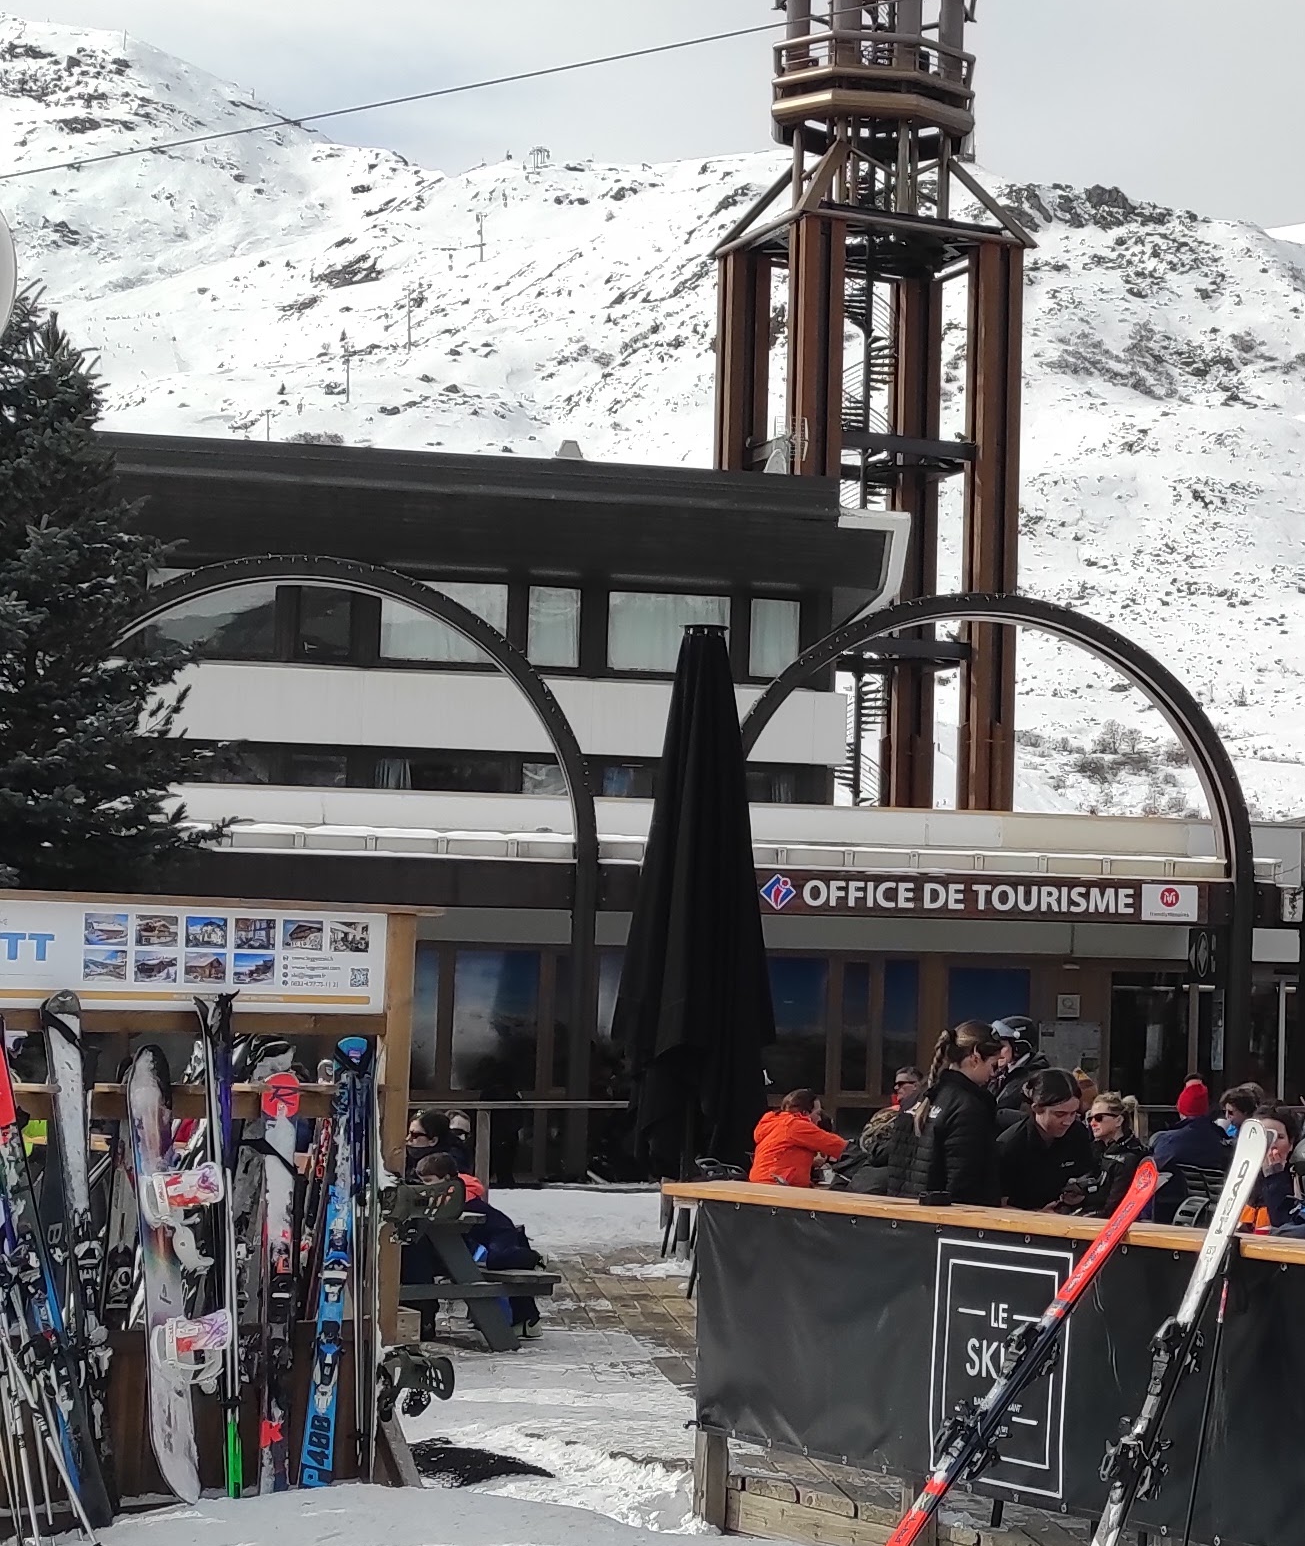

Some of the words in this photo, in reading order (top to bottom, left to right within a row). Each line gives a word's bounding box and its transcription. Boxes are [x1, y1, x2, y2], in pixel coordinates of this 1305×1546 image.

[802, 879, 915, 910] OFFICE
[923, 882, 965, 911] DE
[972, 883, 1135, 914] TOURISME
[1214, 1159, 1250, 1235] HEAD
[990, 1302, 1009, 1329] LE
